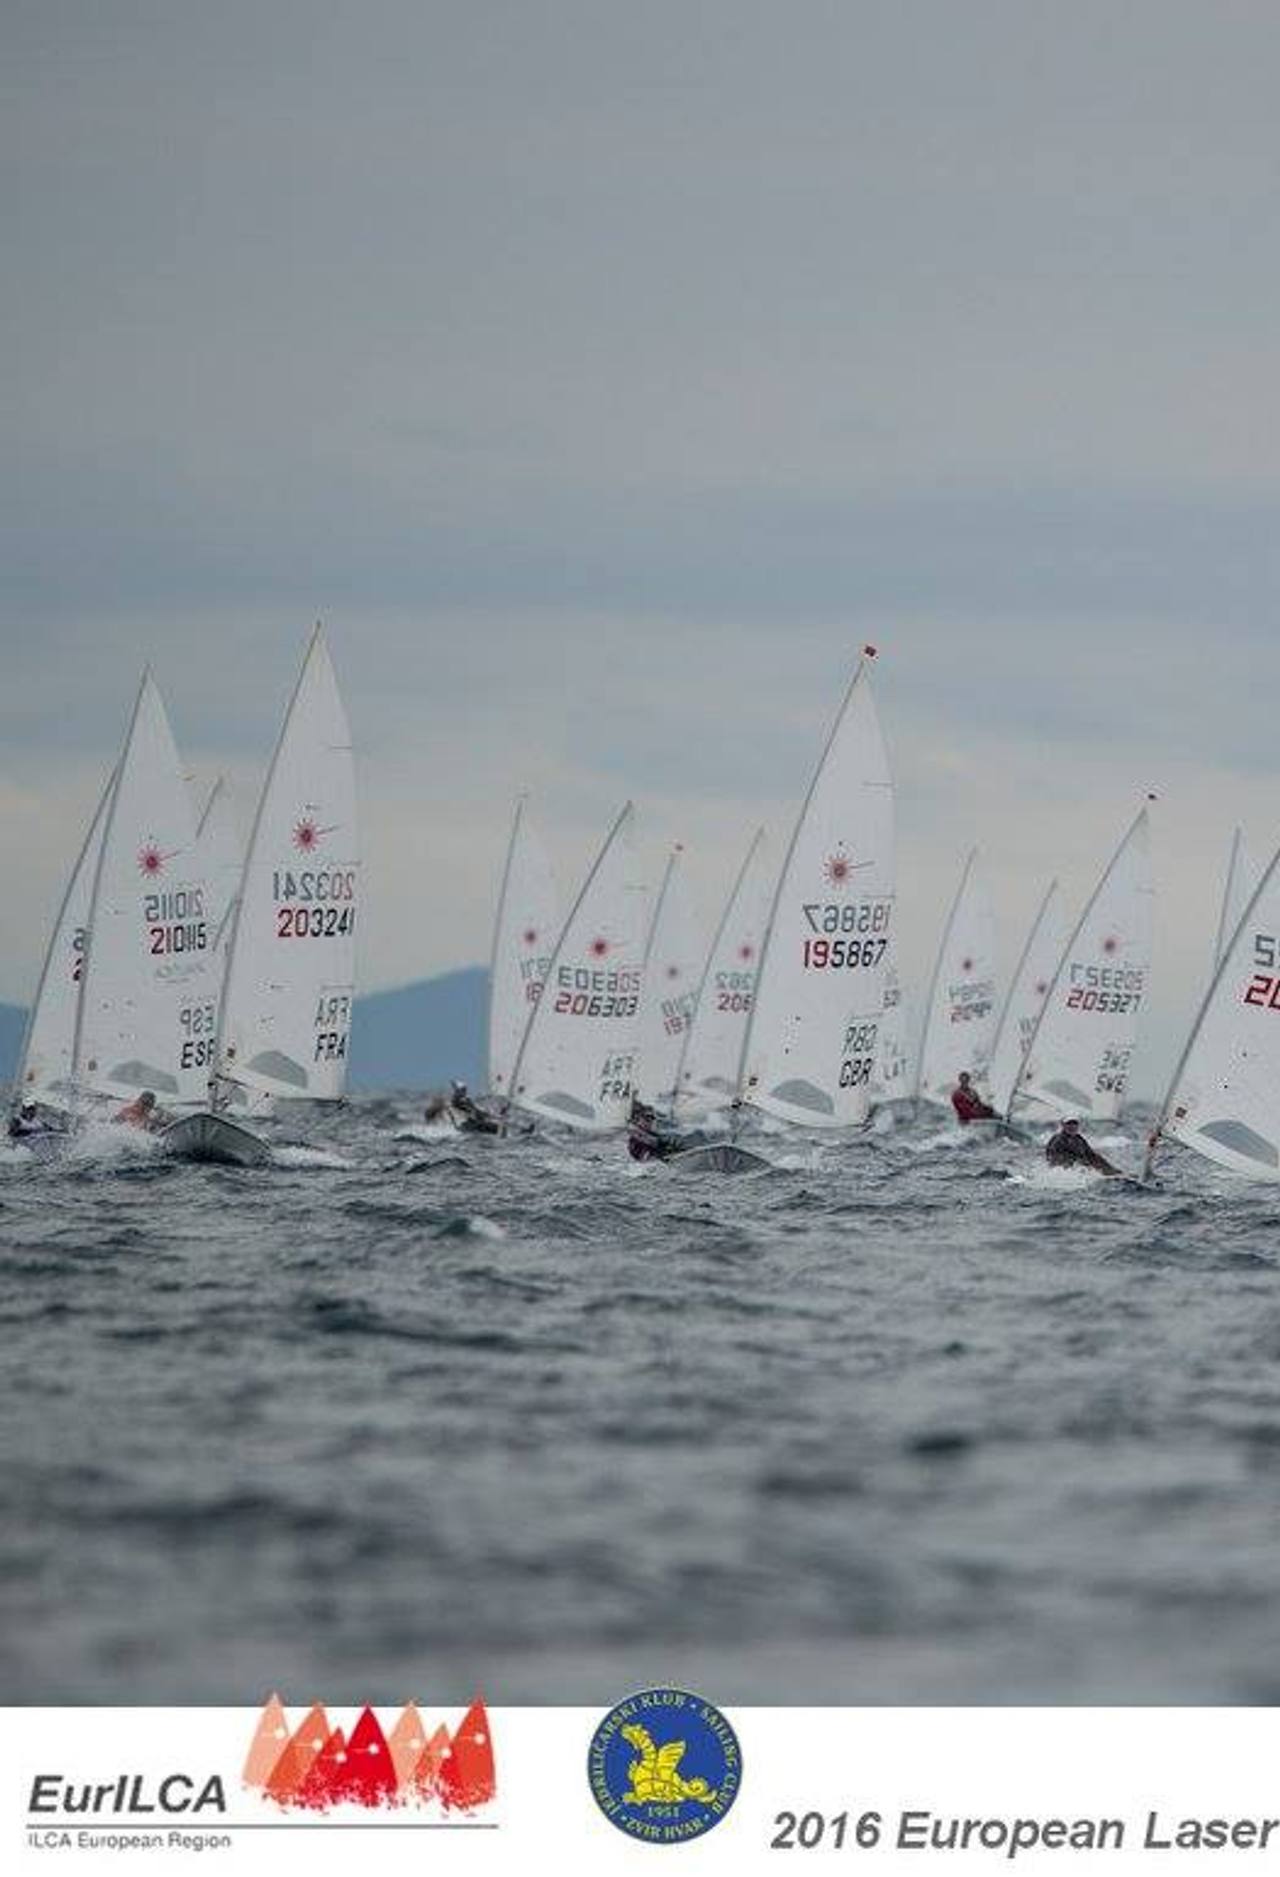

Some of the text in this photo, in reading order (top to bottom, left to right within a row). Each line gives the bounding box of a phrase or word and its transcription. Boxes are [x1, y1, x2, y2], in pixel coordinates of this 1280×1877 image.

[277, 908, 354, 938] 203241
[804, 939, 887, 968] 195867
[315, 1033, 346, 1062] FRA
